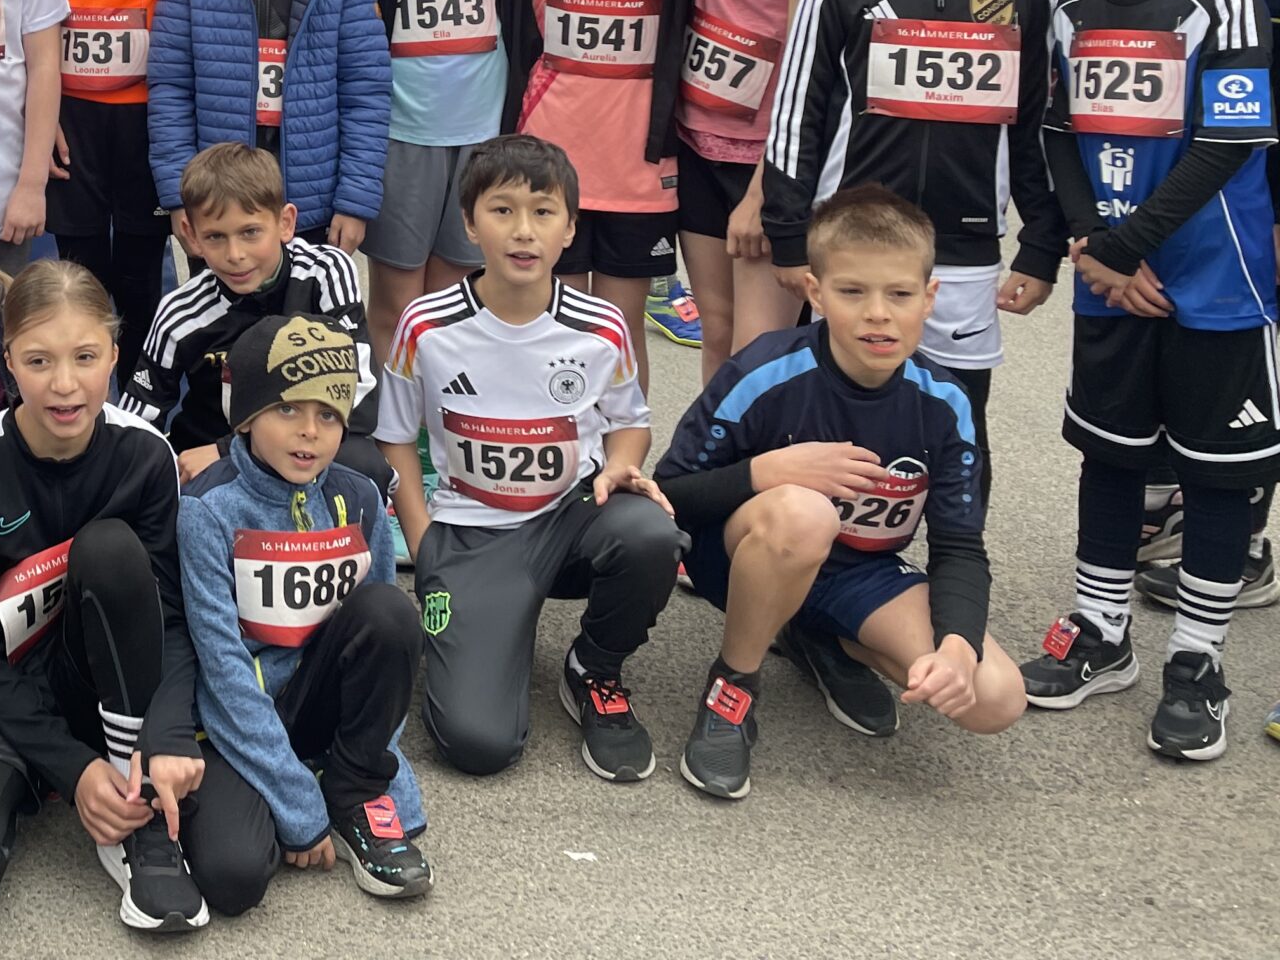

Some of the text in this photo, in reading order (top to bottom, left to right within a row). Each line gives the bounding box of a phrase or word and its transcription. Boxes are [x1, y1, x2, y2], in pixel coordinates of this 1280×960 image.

[433, 30, 451, 38] Ella
[557, 14, 643, 51] 1541
[63, 30, 131, 64] 1531
[582, 52, 617, 62] Aurelia
[75, 66, 110, 74] Leonard
[888, 48, 1001, 91] 1532
[1074, 60, 1163, 103] 1525
[925, 91, 964, 102] Maxim
[1091, 103, 1114, 112] Elias
[1214, 101, 1260, 113] PLAN
[457, 440, 564, 482] 1529
[493, 483, 526, 494] Jonas
[254, 559, 358, 610] 1688
